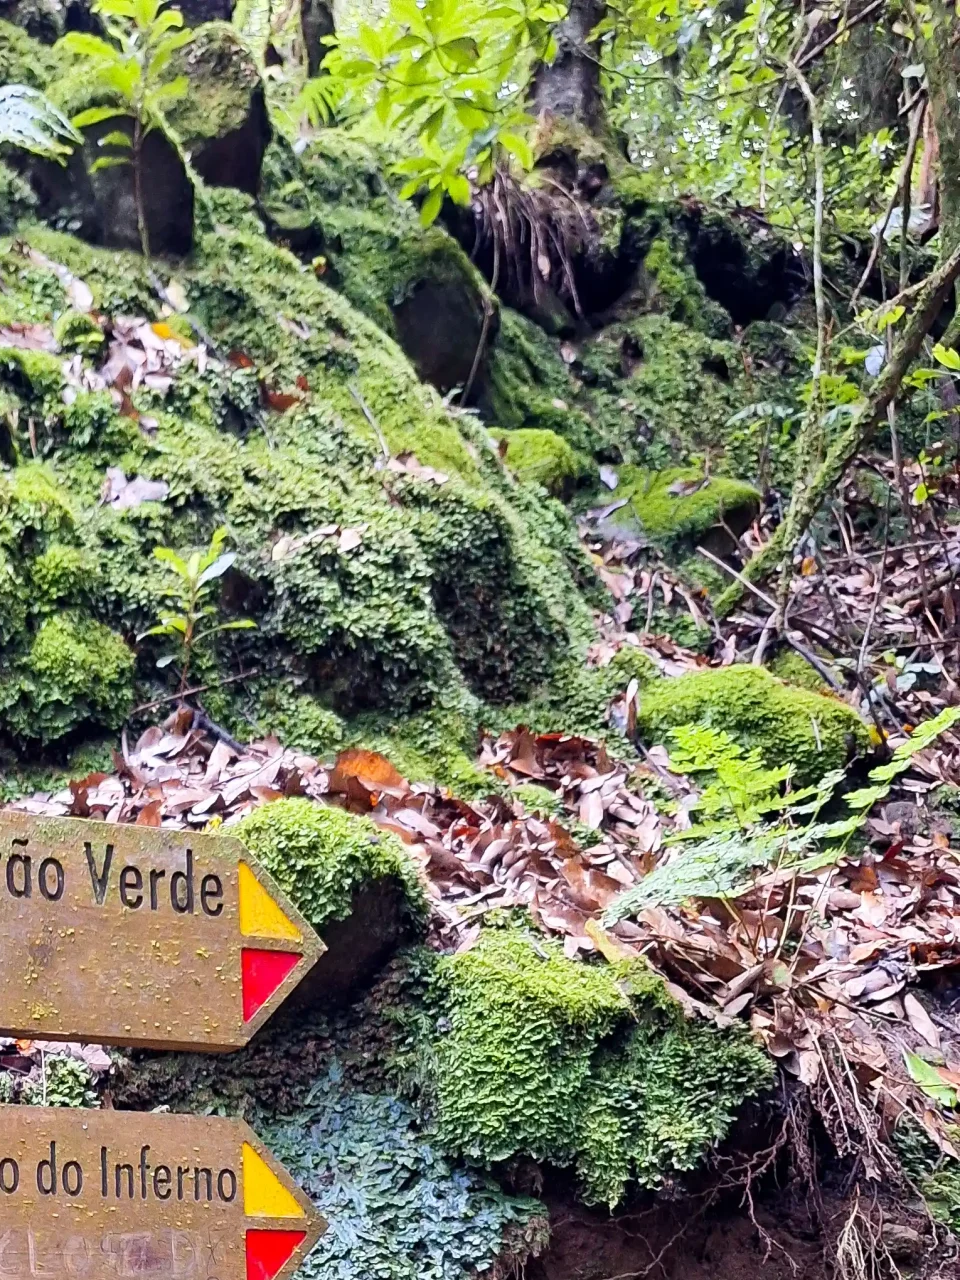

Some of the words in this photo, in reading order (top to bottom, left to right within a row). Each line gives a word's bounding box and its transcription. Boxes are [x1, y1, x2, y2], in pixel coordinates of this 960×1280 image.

[83, 842, 224, 917] Verde
[36, 1141, 83, 1197] do
[100, 1145, 238, 1203] Inferno
